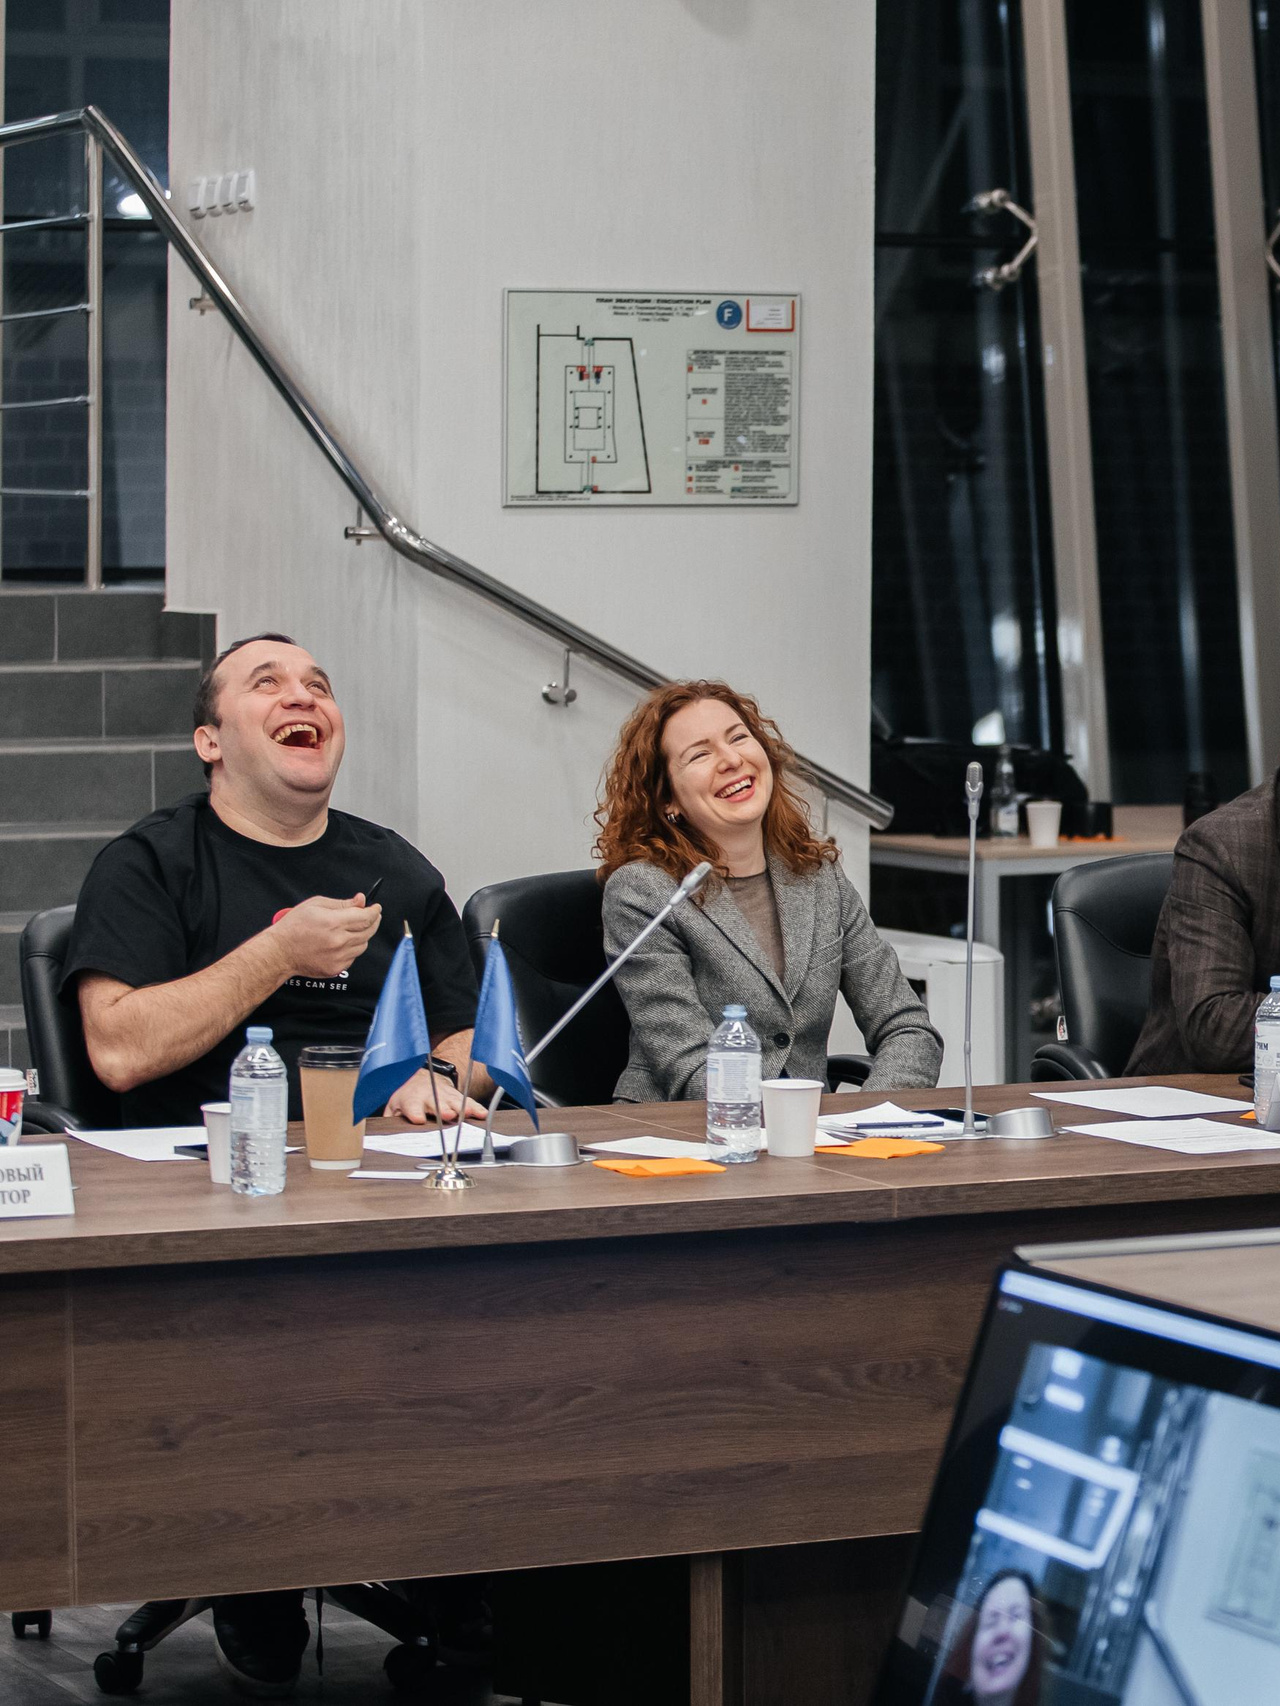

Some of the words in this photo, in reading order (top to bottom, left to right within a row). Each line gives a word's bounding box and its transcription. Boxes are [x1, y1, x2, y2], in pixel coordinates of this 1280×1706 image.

[723, 308, 733, 322] F
[305, 981, 325, 989] CAN
[330, 983, 348, 991] SEE
